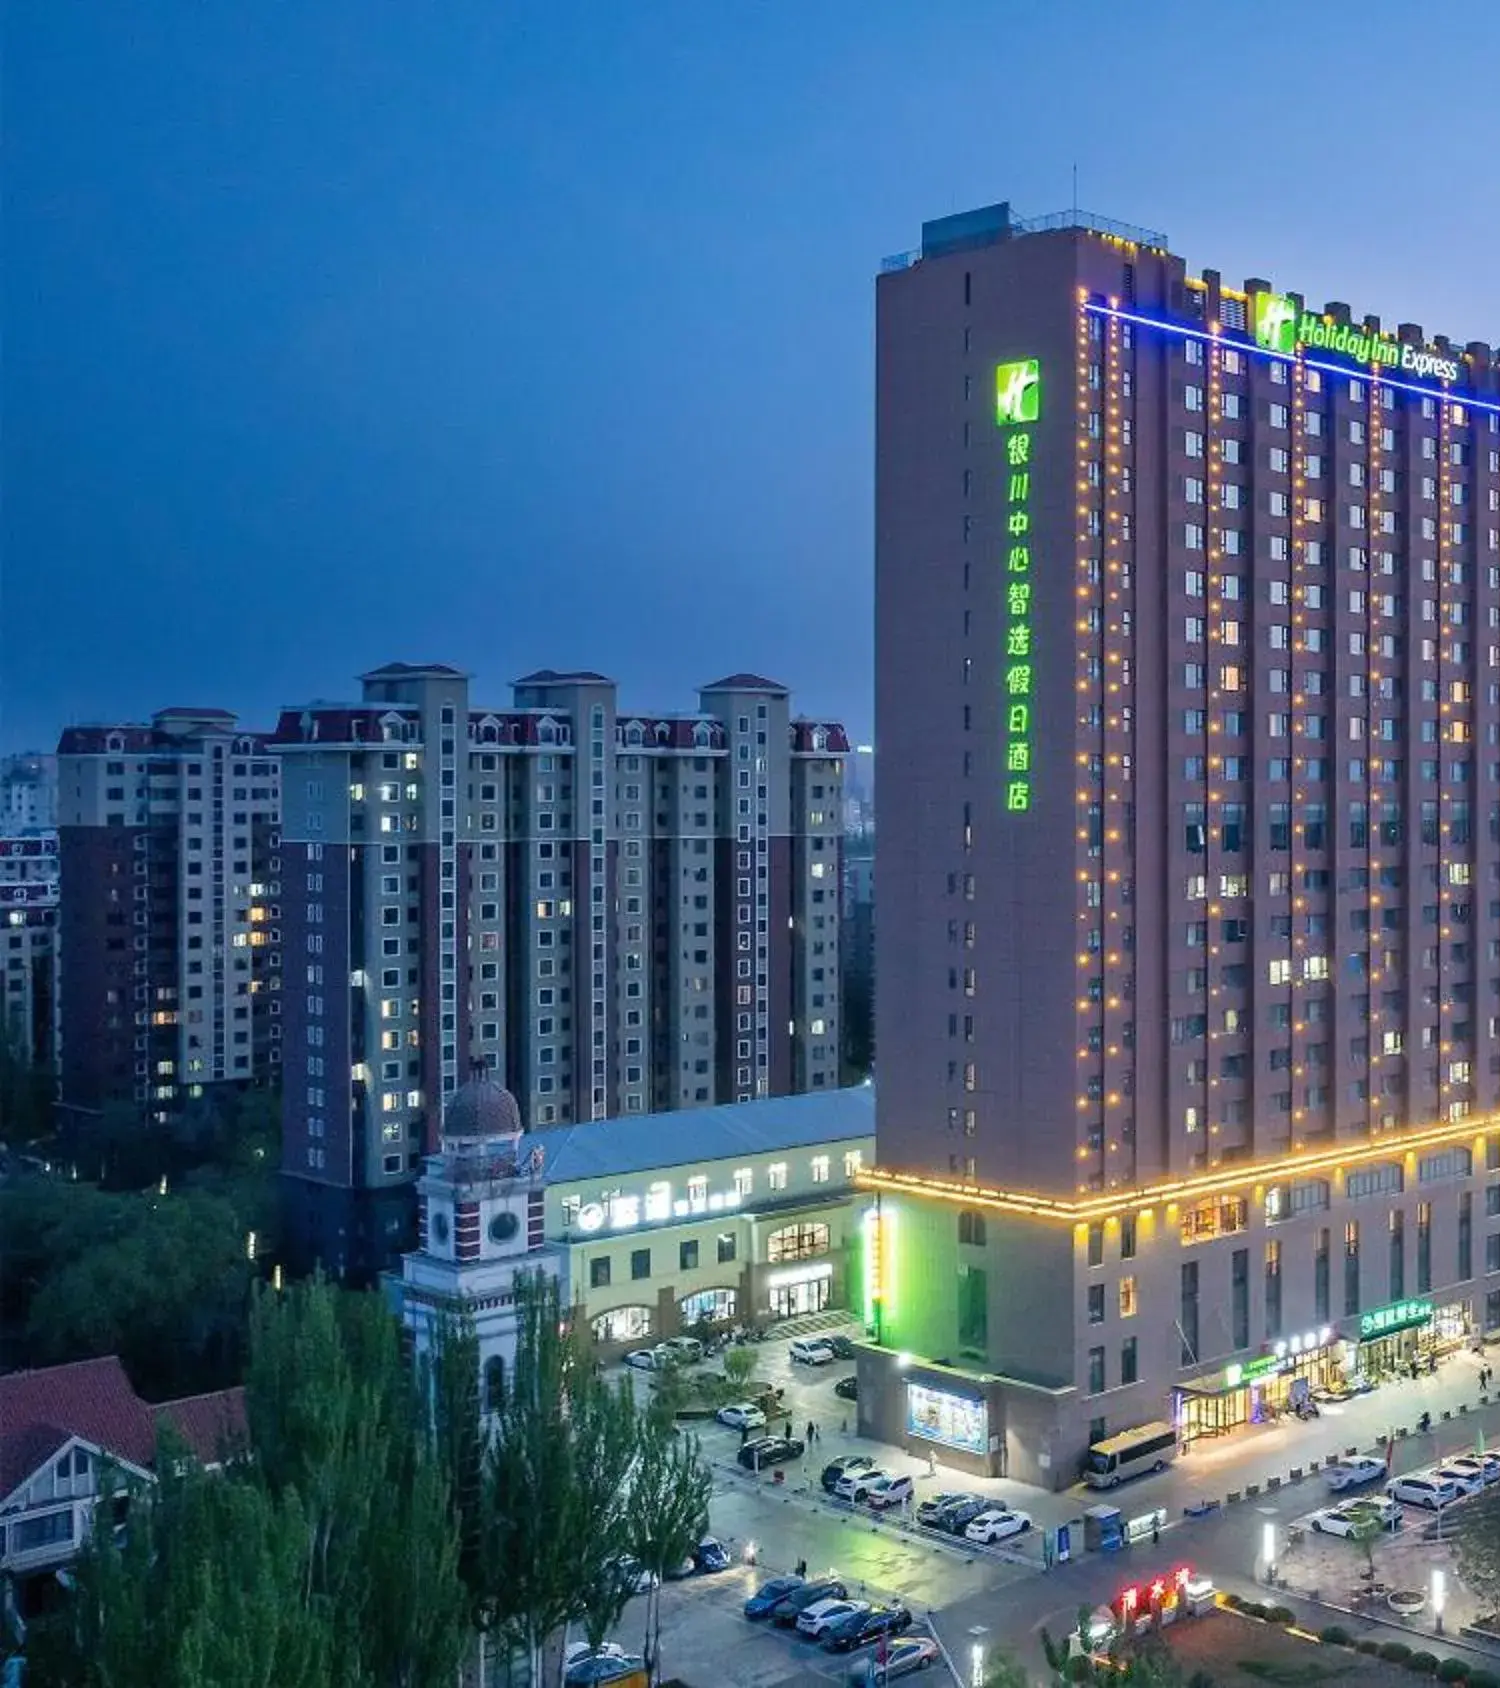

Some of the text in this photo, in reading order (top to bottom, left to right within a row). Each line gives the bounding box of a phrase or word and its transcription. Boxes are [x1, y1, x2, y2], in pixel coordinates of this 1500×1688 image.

[1299, 313, 1457, 380] Holiday Inn Express
[1007, 433, 1030, 811] 银川中心智选假日酒店
